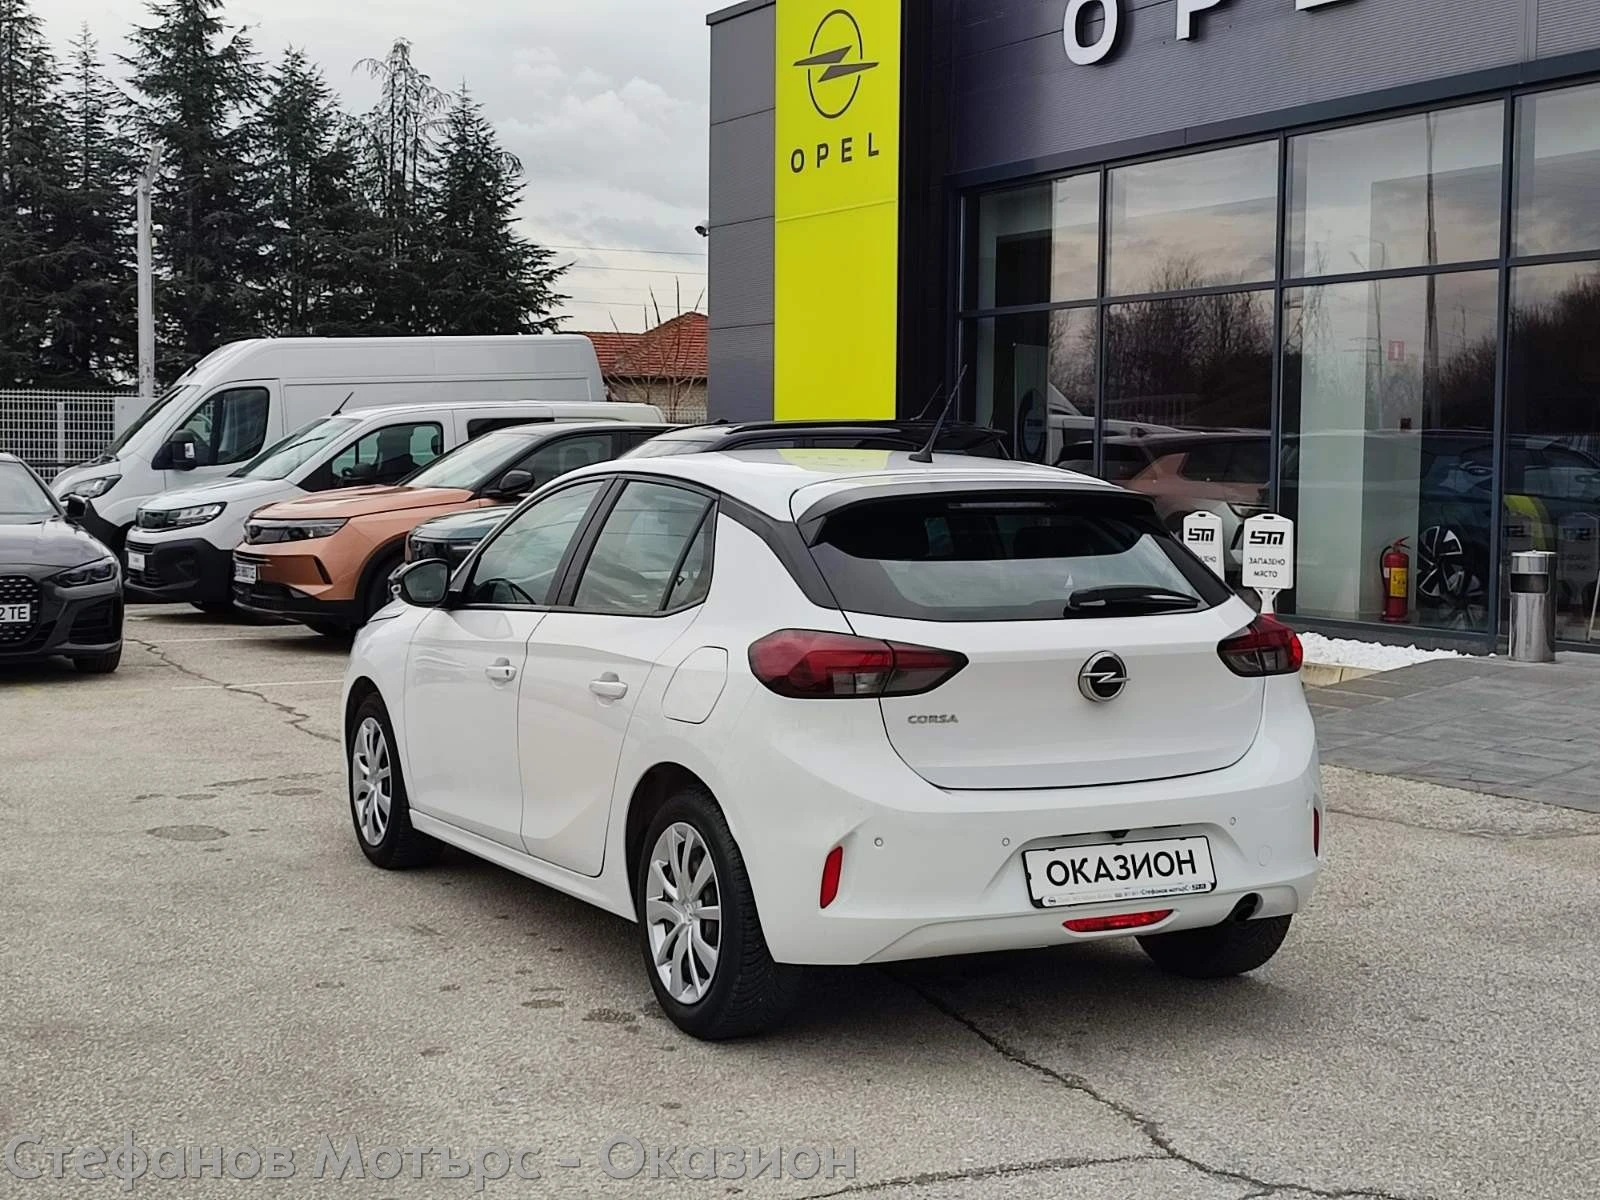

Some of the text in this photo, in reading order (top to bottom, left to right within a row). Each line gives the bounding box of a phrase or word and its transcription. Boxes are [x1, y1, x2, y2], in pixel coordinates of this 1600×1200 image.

[790, 132, 880, 173] OPEL
[1249, 557, 1286, 566] ЗАПАЗЕНО
[8, 606, 27, 620] TE
[907, 714, 959, 724] CORSA
[1046, 849, 1197, 887] ОКАЗИОН
